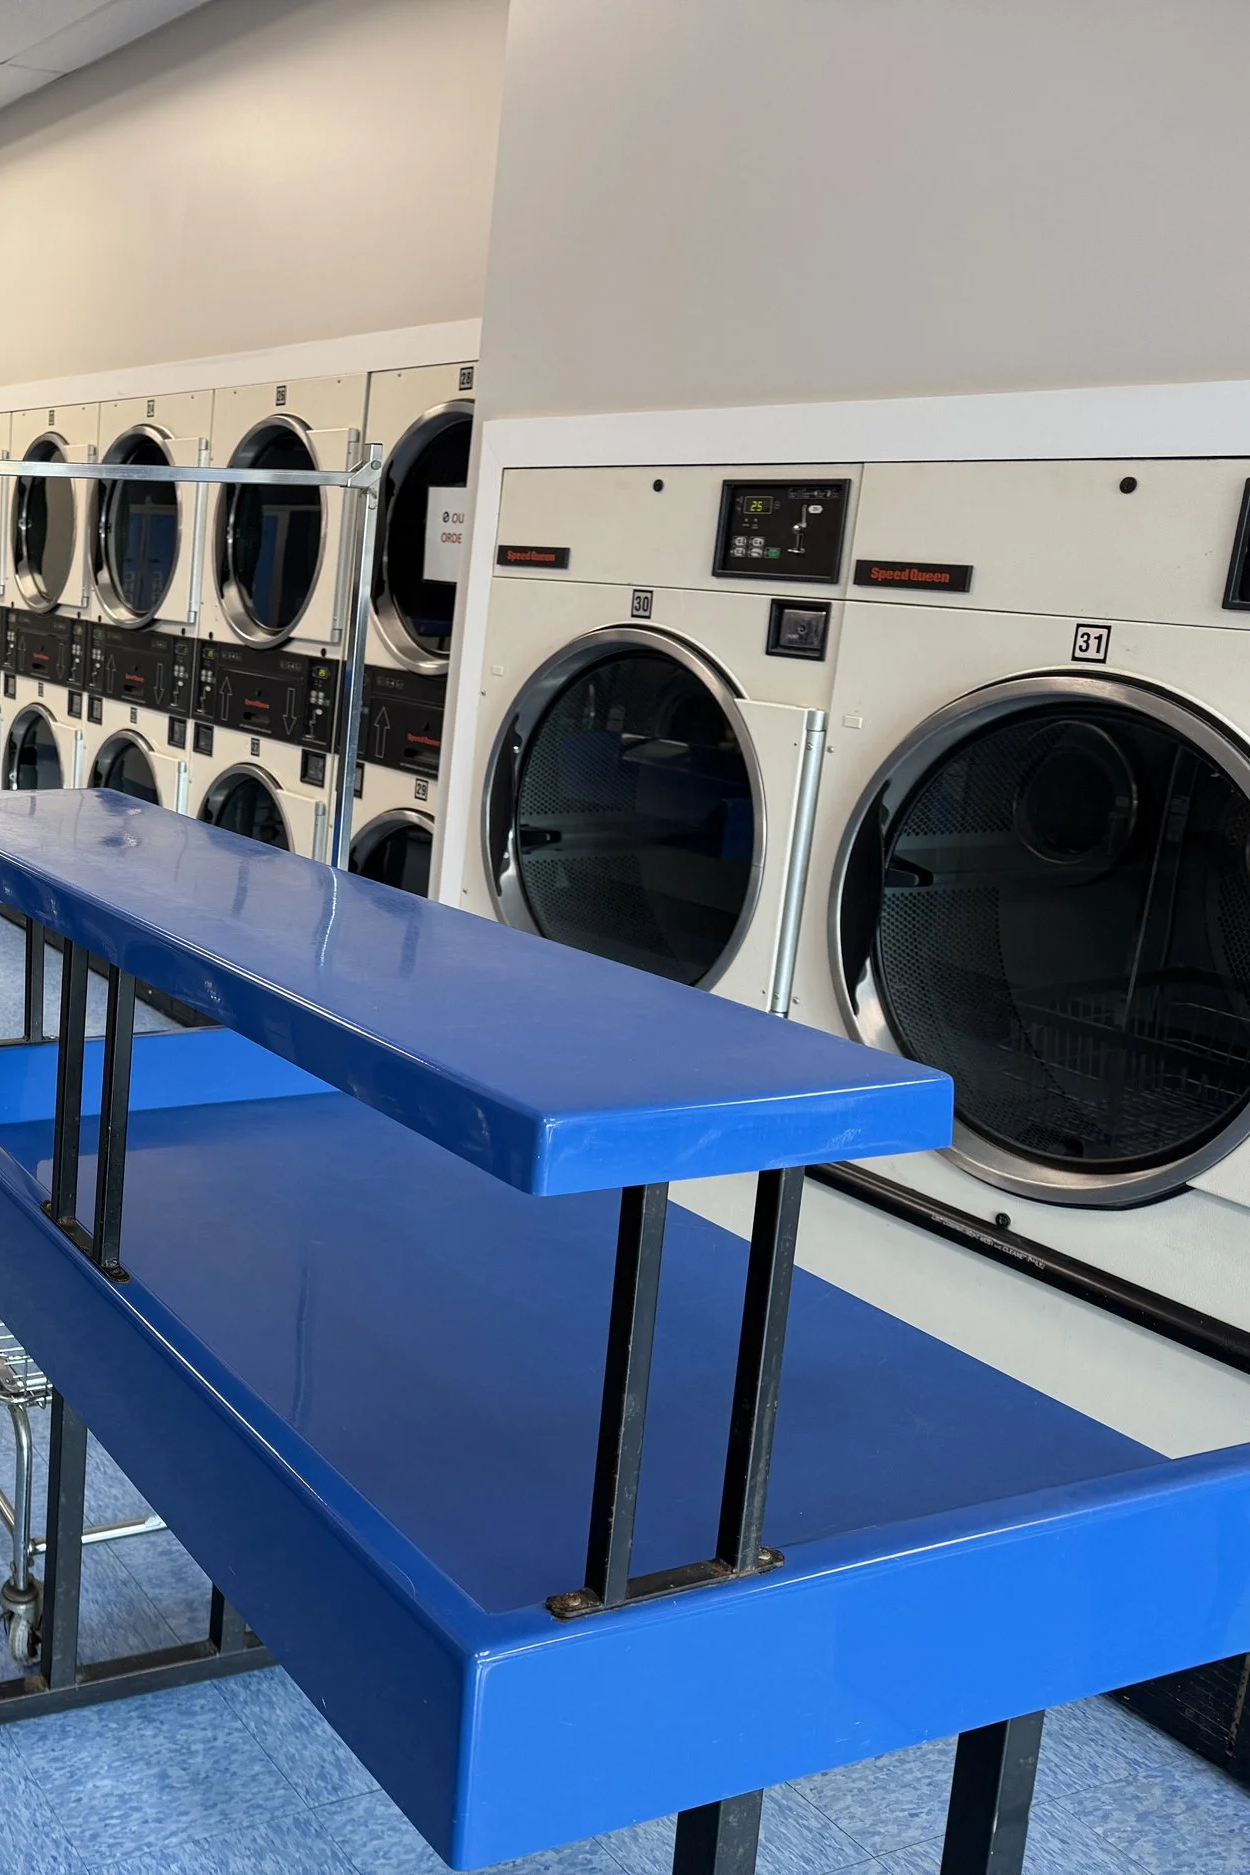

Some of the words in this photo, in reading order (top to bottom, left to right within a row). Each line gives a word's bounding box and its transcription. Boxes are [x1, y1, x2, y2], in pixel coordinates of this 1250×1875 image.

[750, 500, 763, 512] 25
[451, 512, 466, 524] OU
[440, 532, 463, 544] ORDE
[871, 567, 909, 581] Speed
[909, 568, 950, 583] Queen
[634, 595, 650, 612] 30
[1078, 632, 1103, 654] 31
